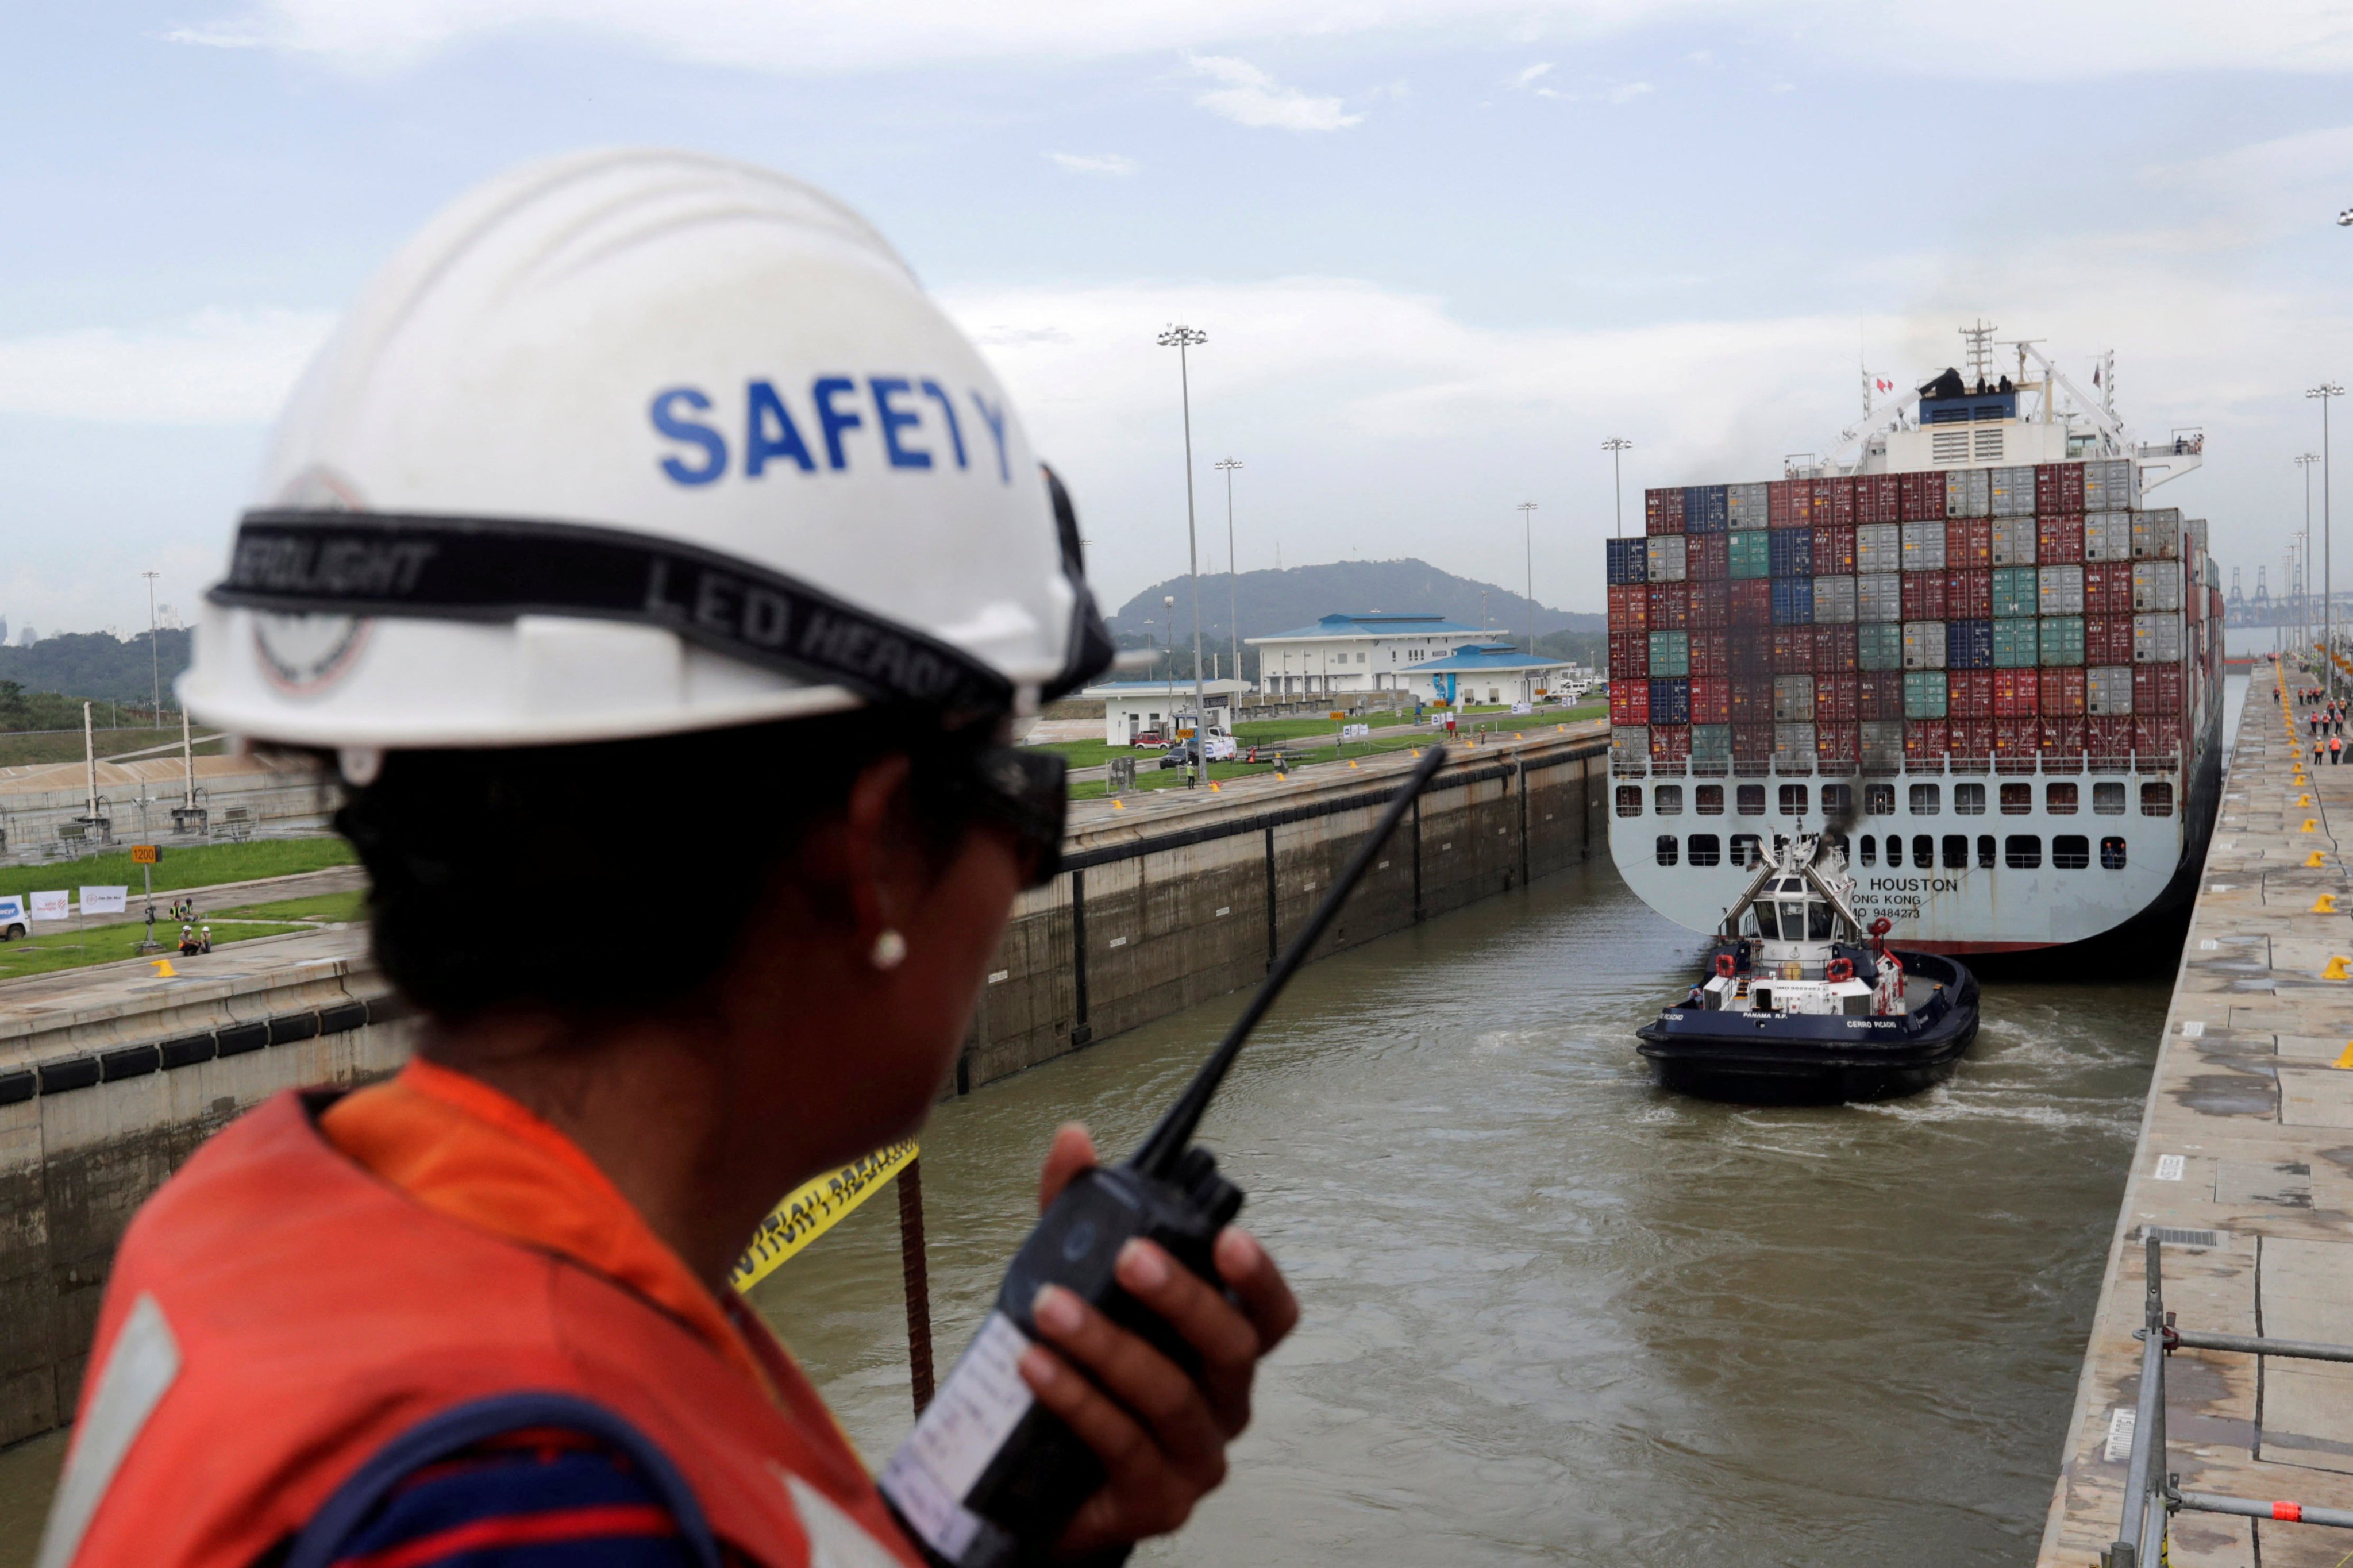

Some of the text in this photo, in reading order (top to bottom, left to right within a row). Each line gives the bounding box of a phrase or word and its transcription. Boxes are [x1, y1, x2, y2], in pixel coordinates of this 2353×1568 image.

[649, 378, 1011, 486] SAFETY
[645, 557, 792, 646] LED
[133, 848, 155, 860] 1200
[1870, 878, 1958, 891] HOUSTON
[1852, 895, 1921, 904] ONG KONG
[1851, 908, 1920, 919] MO 9484273
[1847, 1020, 1896, 1028] CERRO PICACHO
